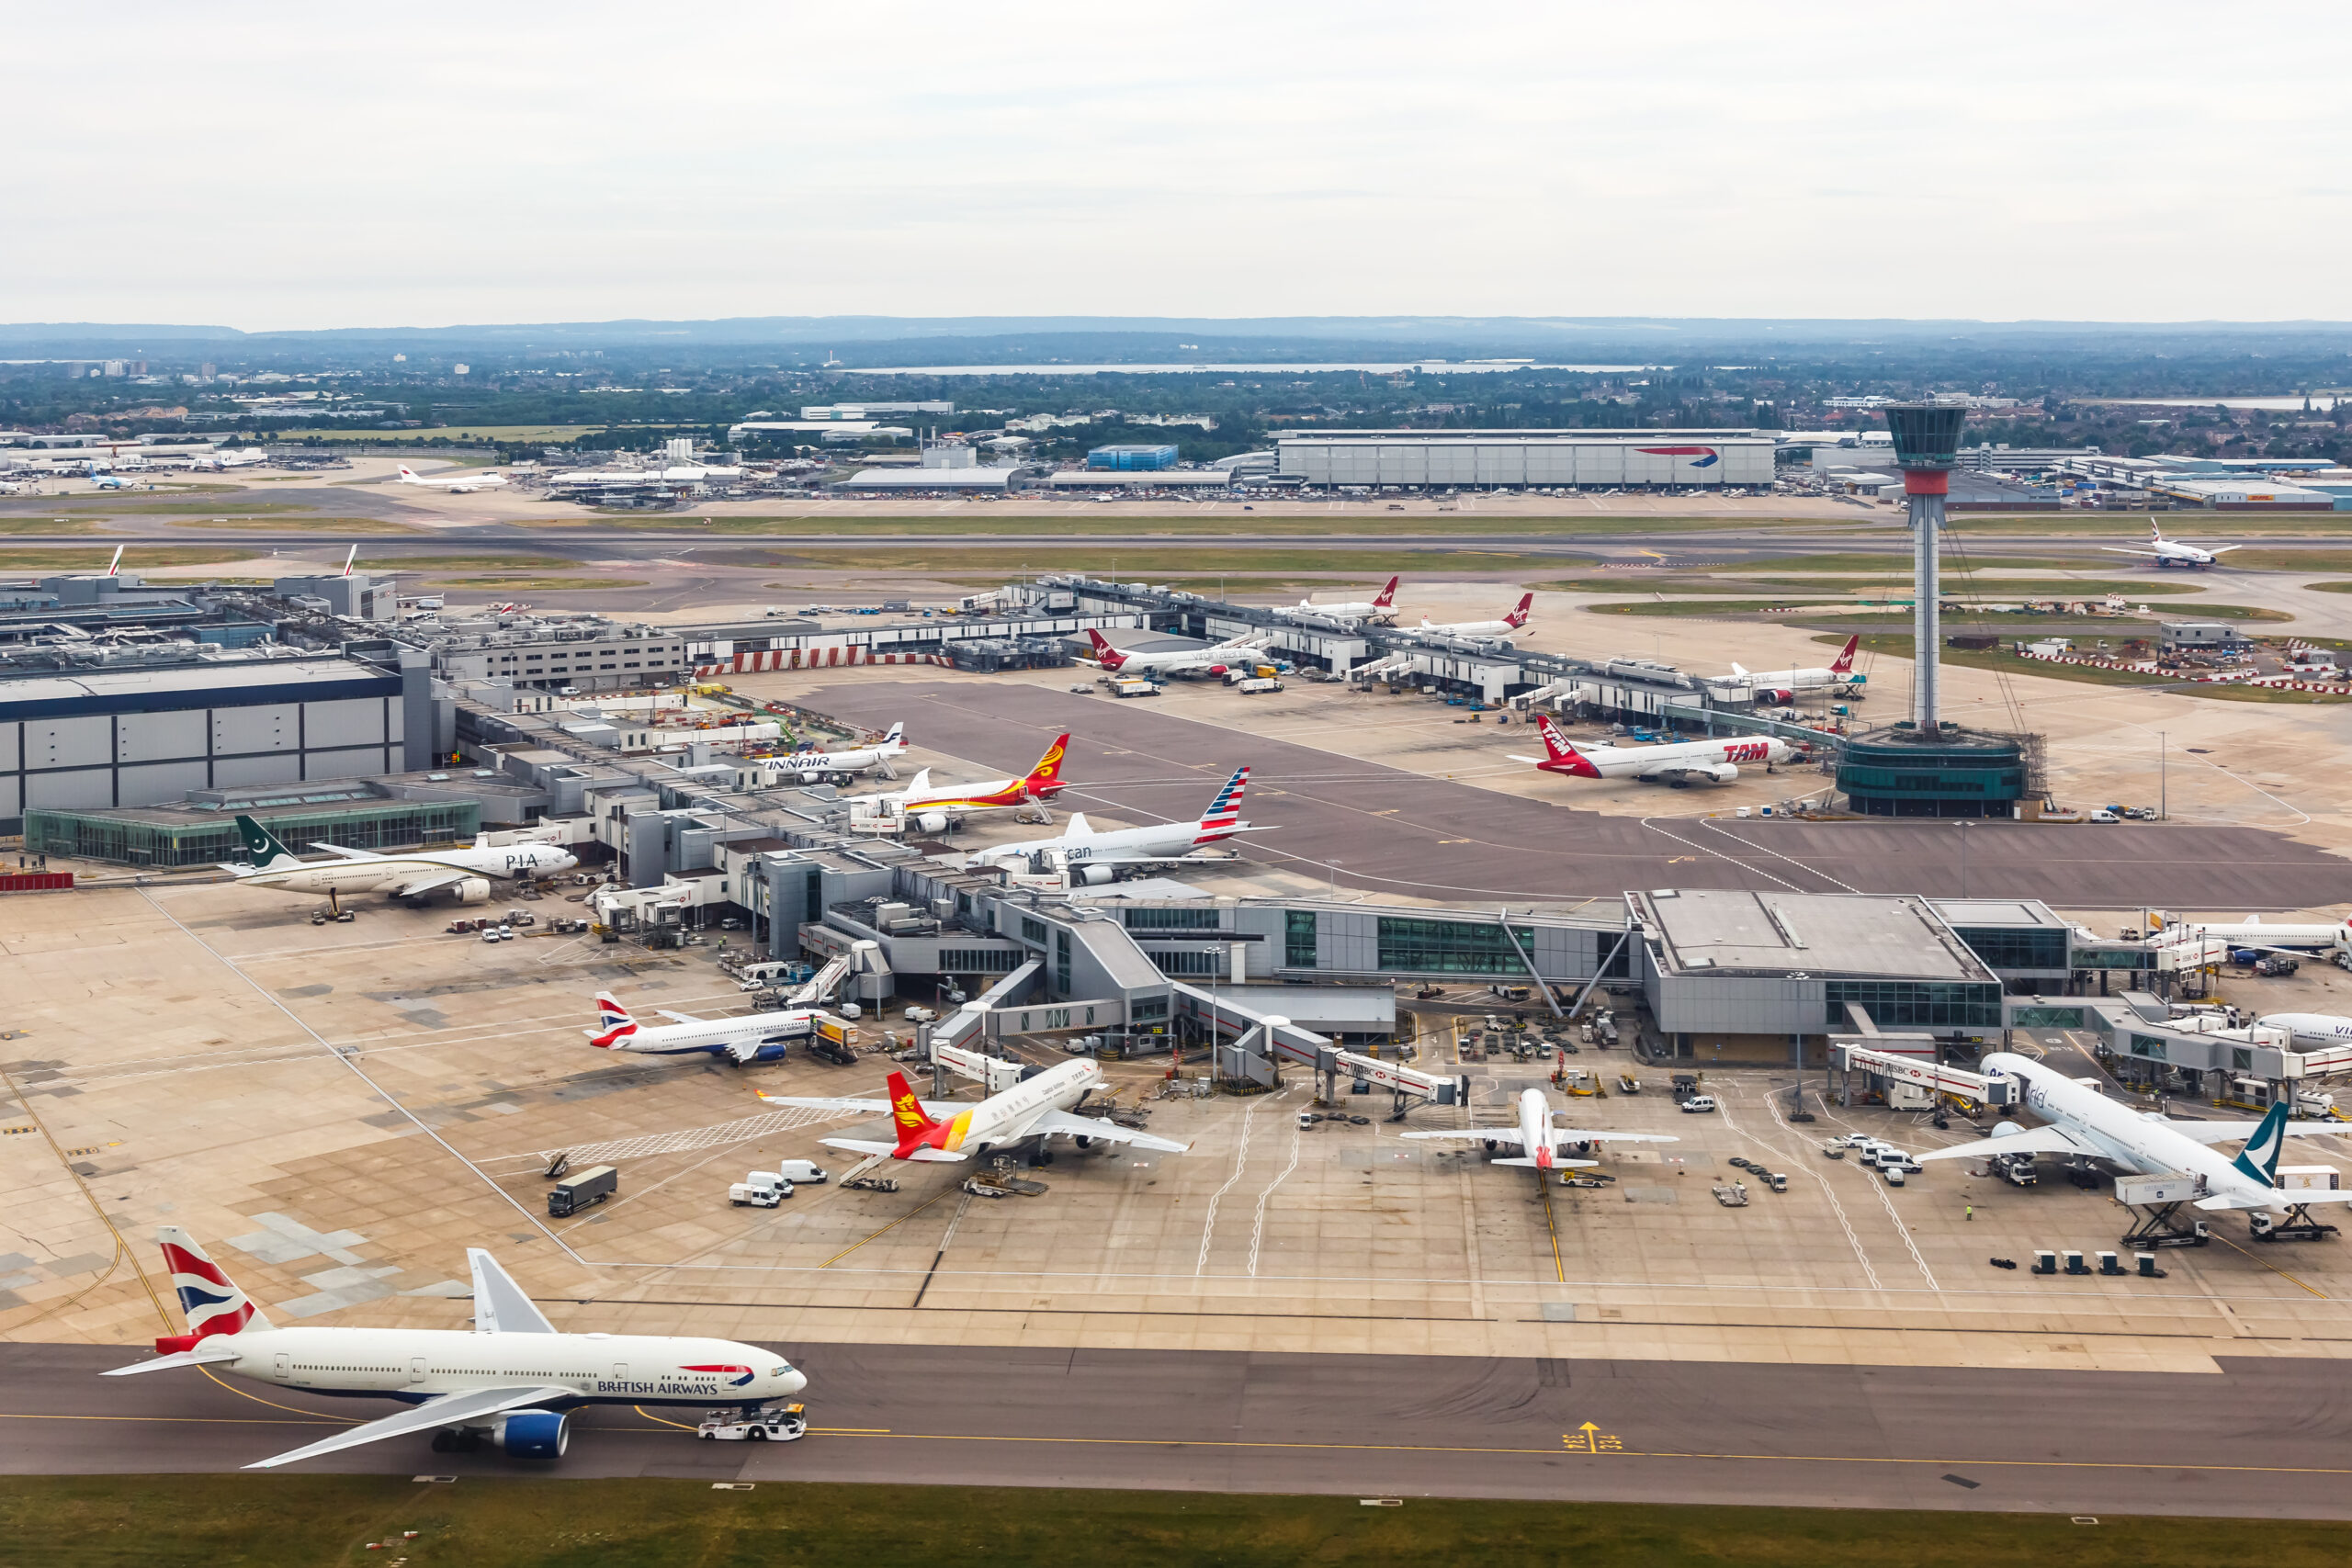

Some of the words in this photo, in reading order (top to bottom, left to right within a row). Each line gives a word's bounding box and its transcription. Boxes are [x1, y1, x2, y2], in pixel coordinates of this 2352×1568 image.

[1542, 722, 1572, 756] TAM
[1723, 742, 1769, 762] TAM
[506, 853, 538, 869] PIA
[1888, 1063, 1909, 1076] HSBC
[598, 1381, 653, 1393] BRITISH
[657, 1382, 718, 1394] AIRWAYS
